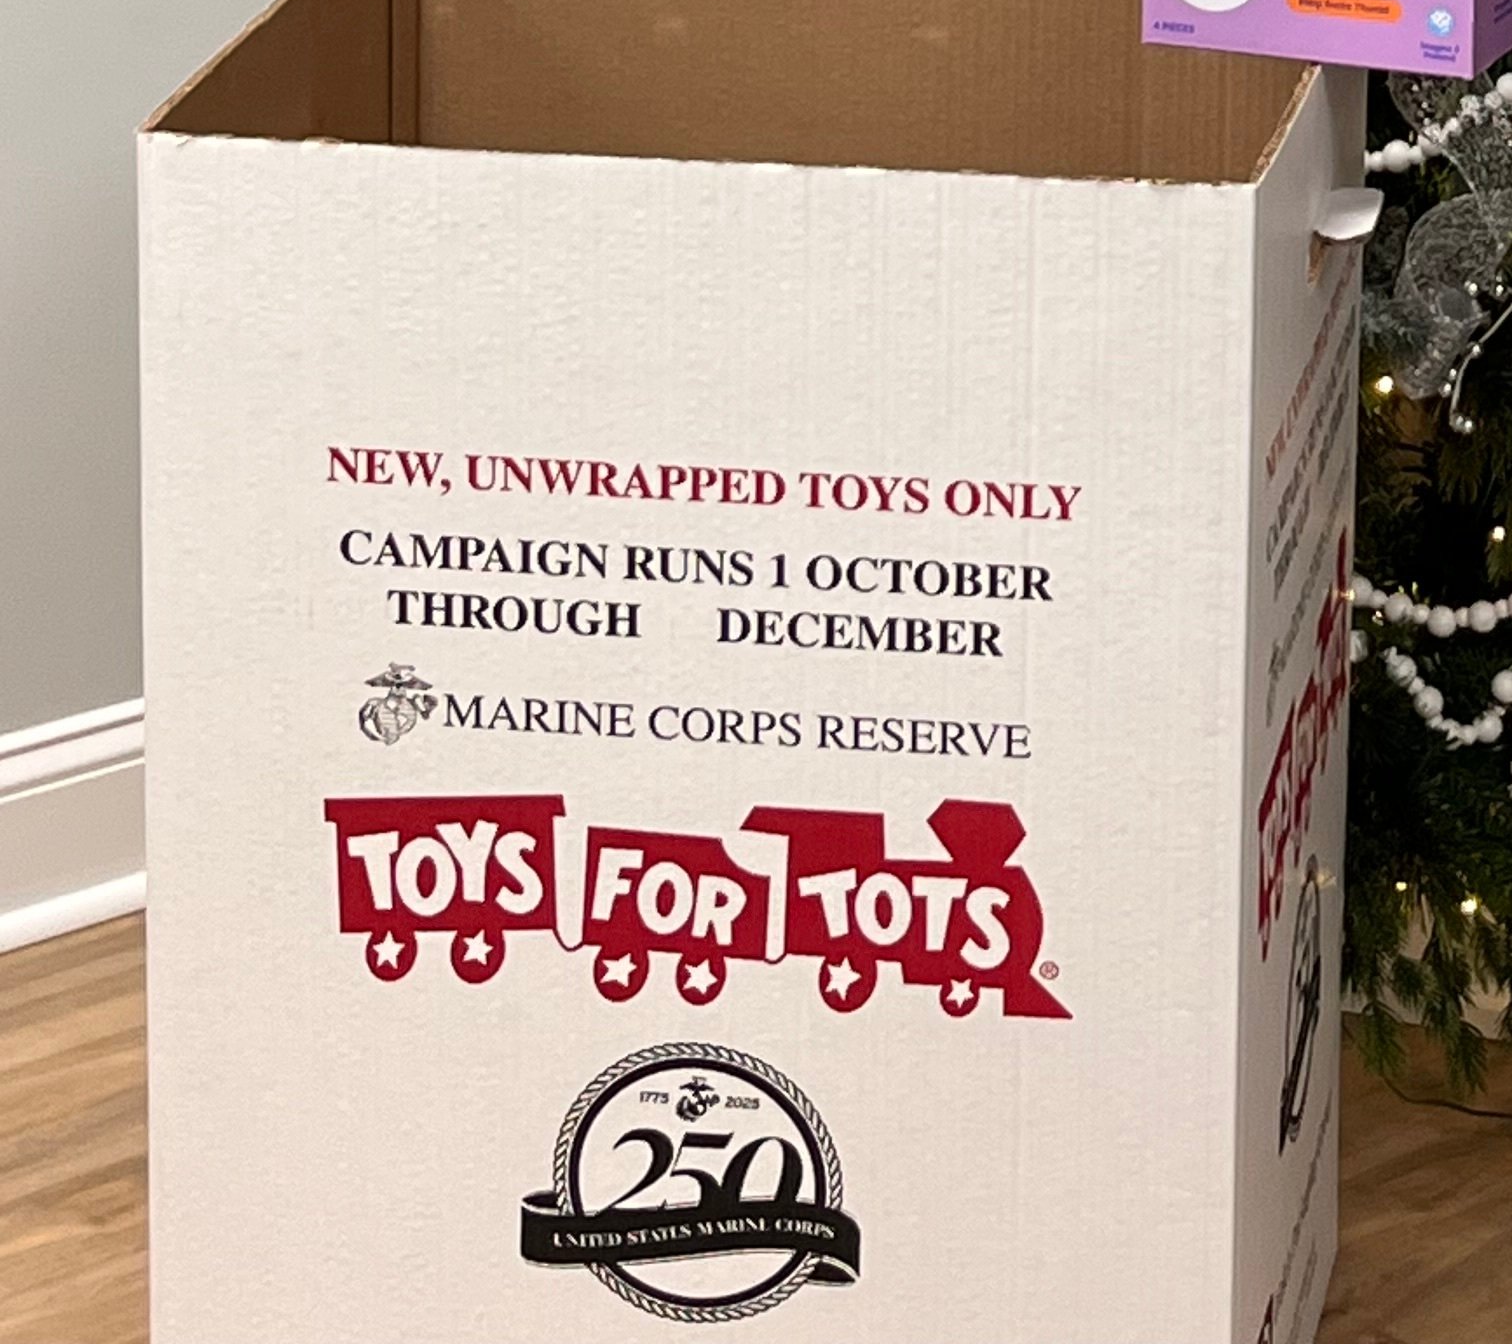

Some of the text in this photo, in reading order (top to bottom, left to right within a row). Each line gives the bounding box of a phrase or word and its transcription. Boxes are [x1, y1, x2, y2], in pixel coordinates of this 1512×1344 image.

[326, 446, 1082, 521] NEW, UNWRAPPED TOYS ONLY
[339, 529, 1054, 602] CAMPAIGN RUNS 1 OCTOBER
[386, 589, 1004, 658] THROUGH DECEMBER
[442, 693, 1032, 760] MARINE CORPS RESERVE
[346, 819, 1011, 970] TOYS FOR TOTS
[639, 1090, 761, 1110] 1775 2025
[598, 1127, 803, 1211] 250
[552, 1215, 837, 1249] UNITED STATES MARINE CORPS
